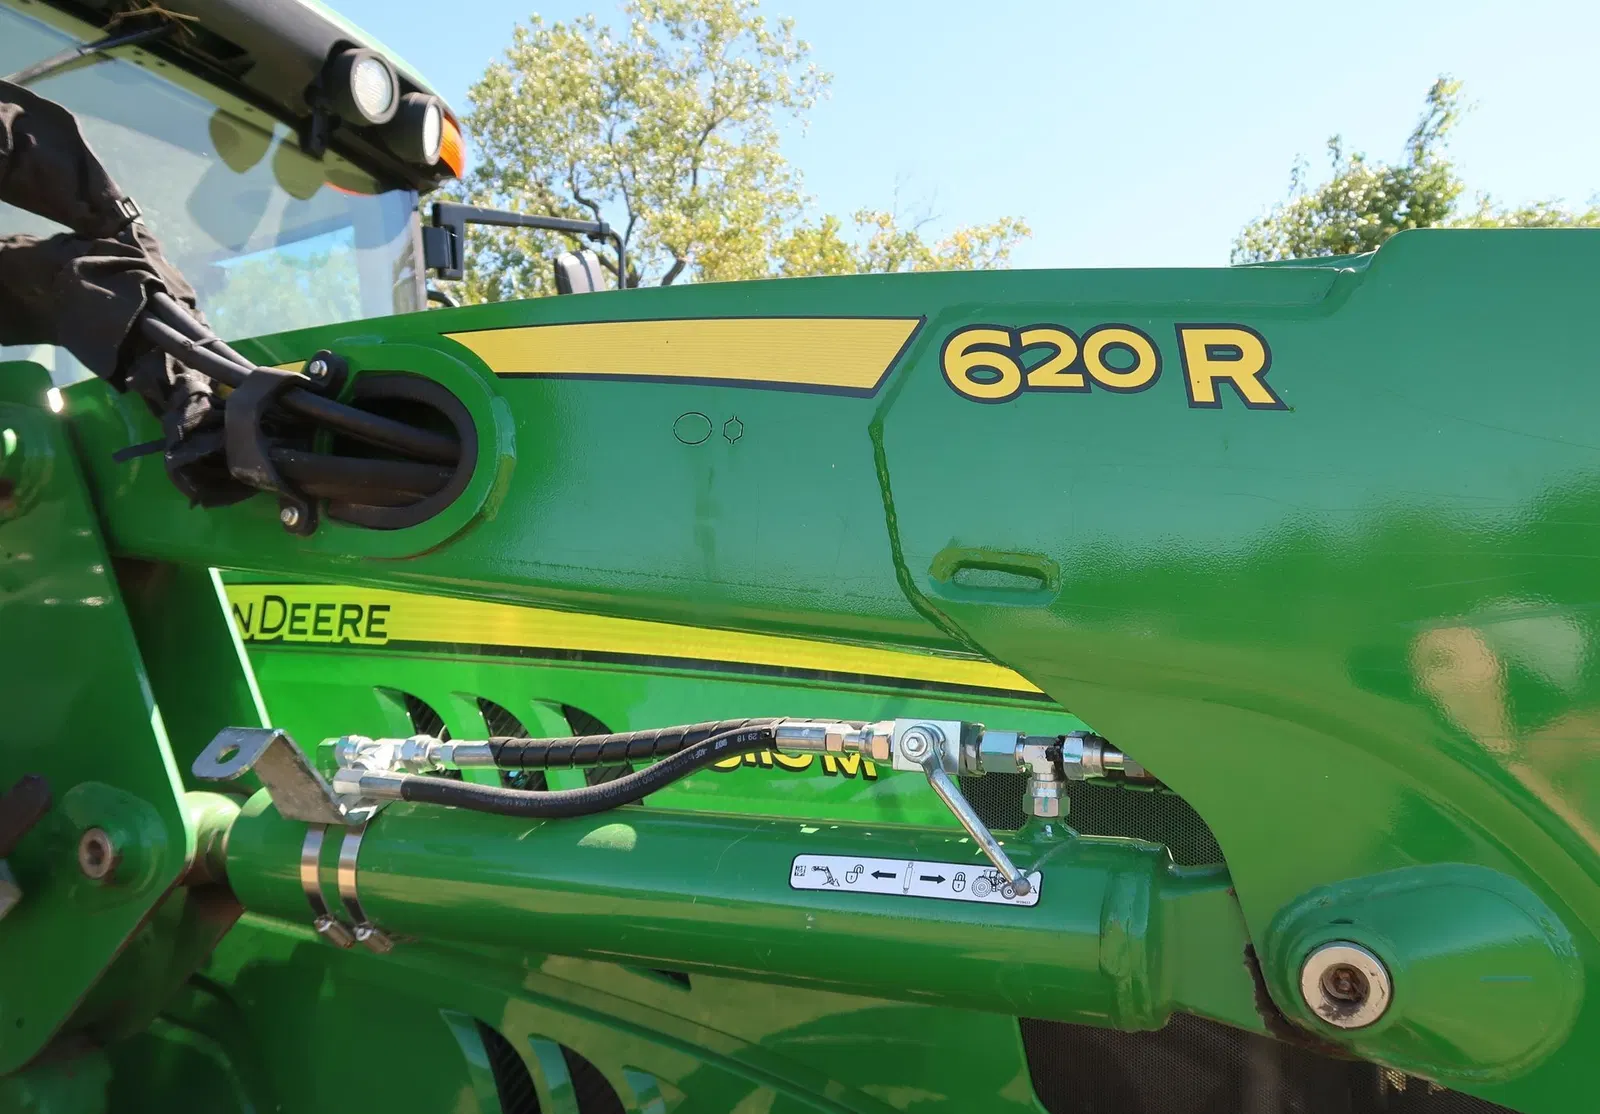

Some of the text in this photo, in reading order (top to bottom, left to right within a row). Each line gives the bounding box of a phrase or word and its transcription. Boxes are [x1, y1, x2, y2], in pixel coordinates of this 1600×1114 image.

[940, 323, 1290, 410] 620 R
[259, 595, 391, 639] DEERE
